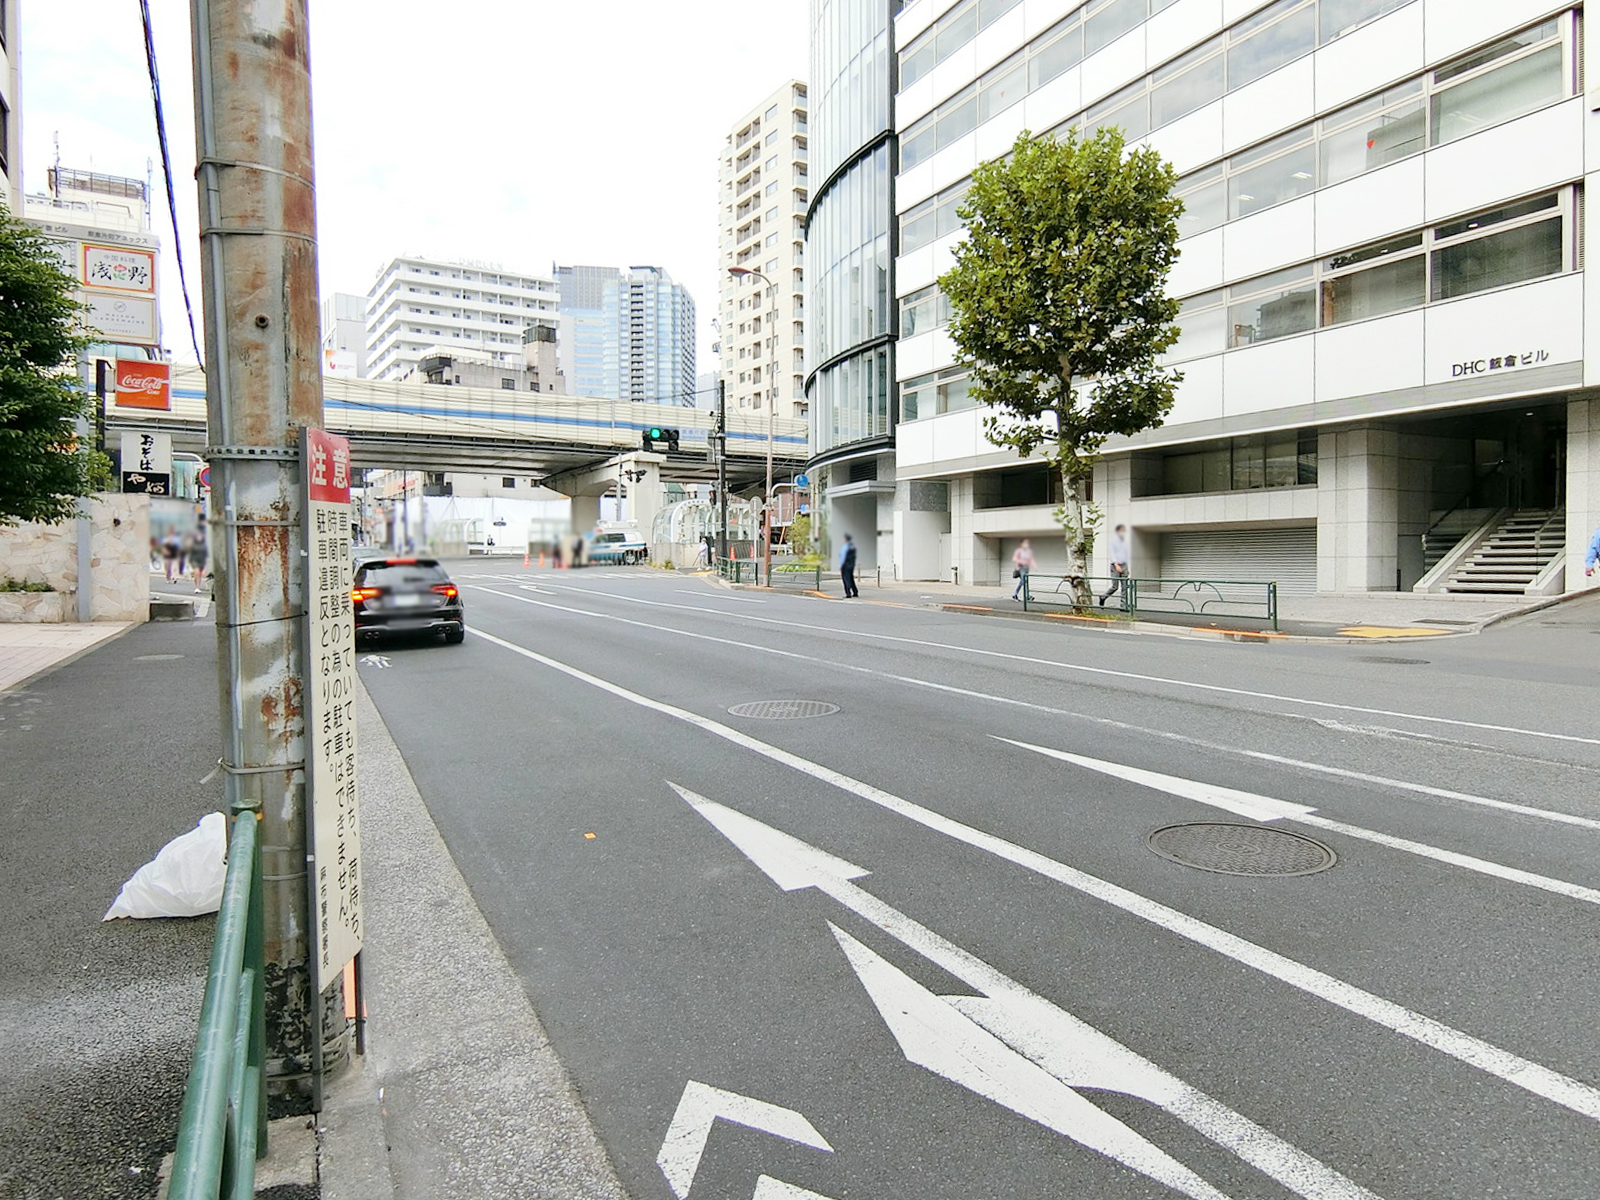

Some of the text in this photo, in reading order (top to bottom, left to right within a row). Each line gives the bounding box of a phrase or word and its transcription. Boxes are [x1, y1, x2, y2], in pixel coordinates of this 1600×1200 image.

[1452, 359, 1486, 377] DHC
[140, 433, 155, 471] おそば
[312, 443, 348, 489] 注意
[316, 508, 334, 773] 駐車違反となります。
